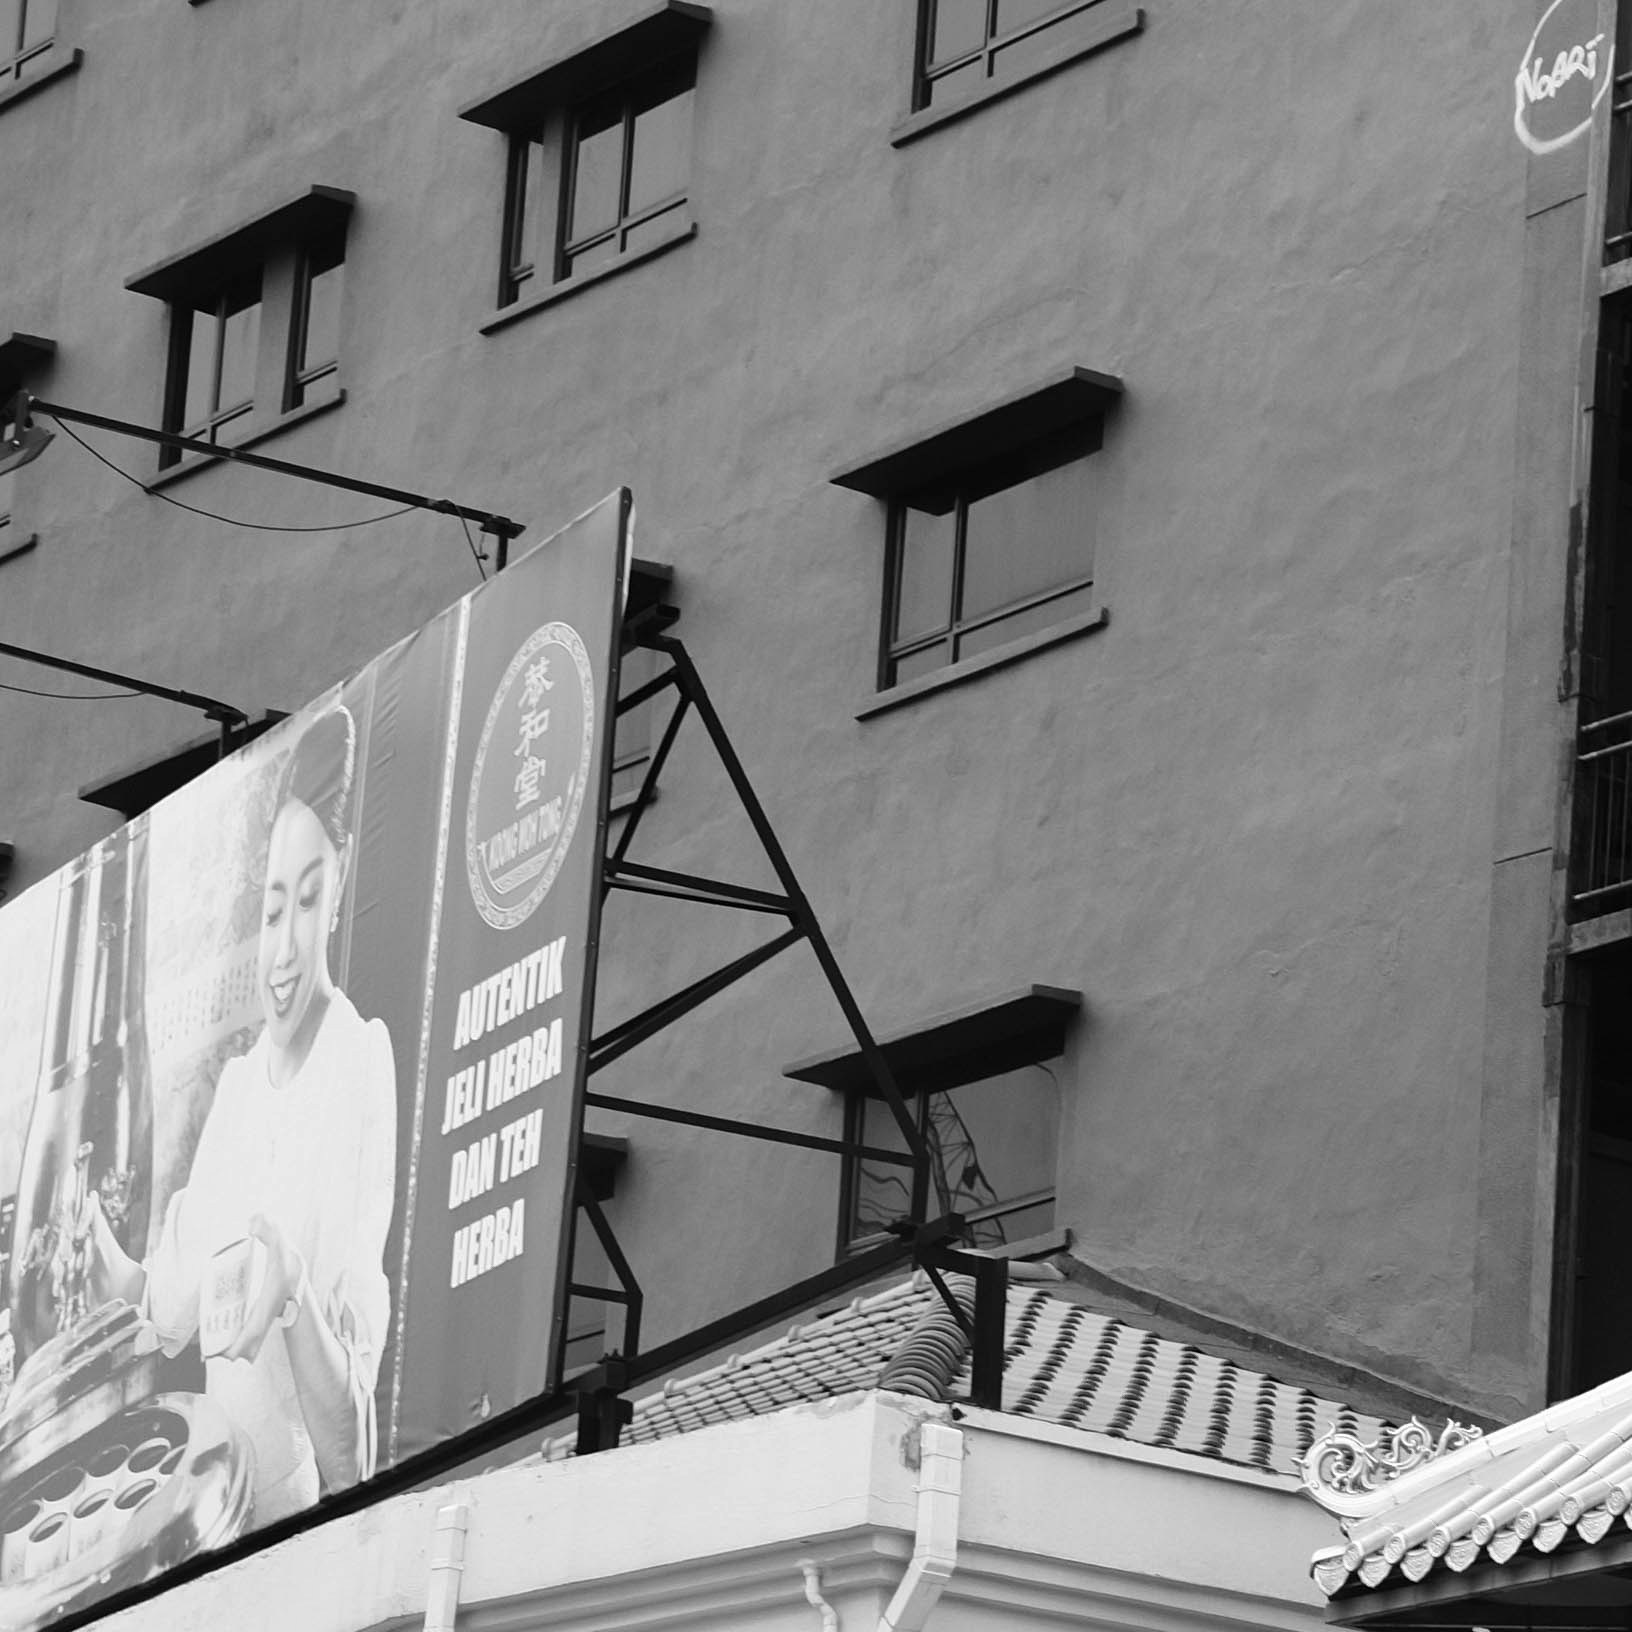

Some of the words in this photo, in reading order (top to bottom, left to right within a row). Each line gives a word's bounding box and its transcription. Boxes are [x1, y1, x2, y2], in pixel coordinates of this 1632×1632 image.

[453, 936, 566, 1050] AUTENTIK
[441, 1060, 485, 1134] JELI
[486, 1018, 563, 1111] HERBA
[448, 1132, 497, 1209] DAN
[499, 1108, 543, 1183] TEH
[451, 1198, 525, 1288] HERBA
